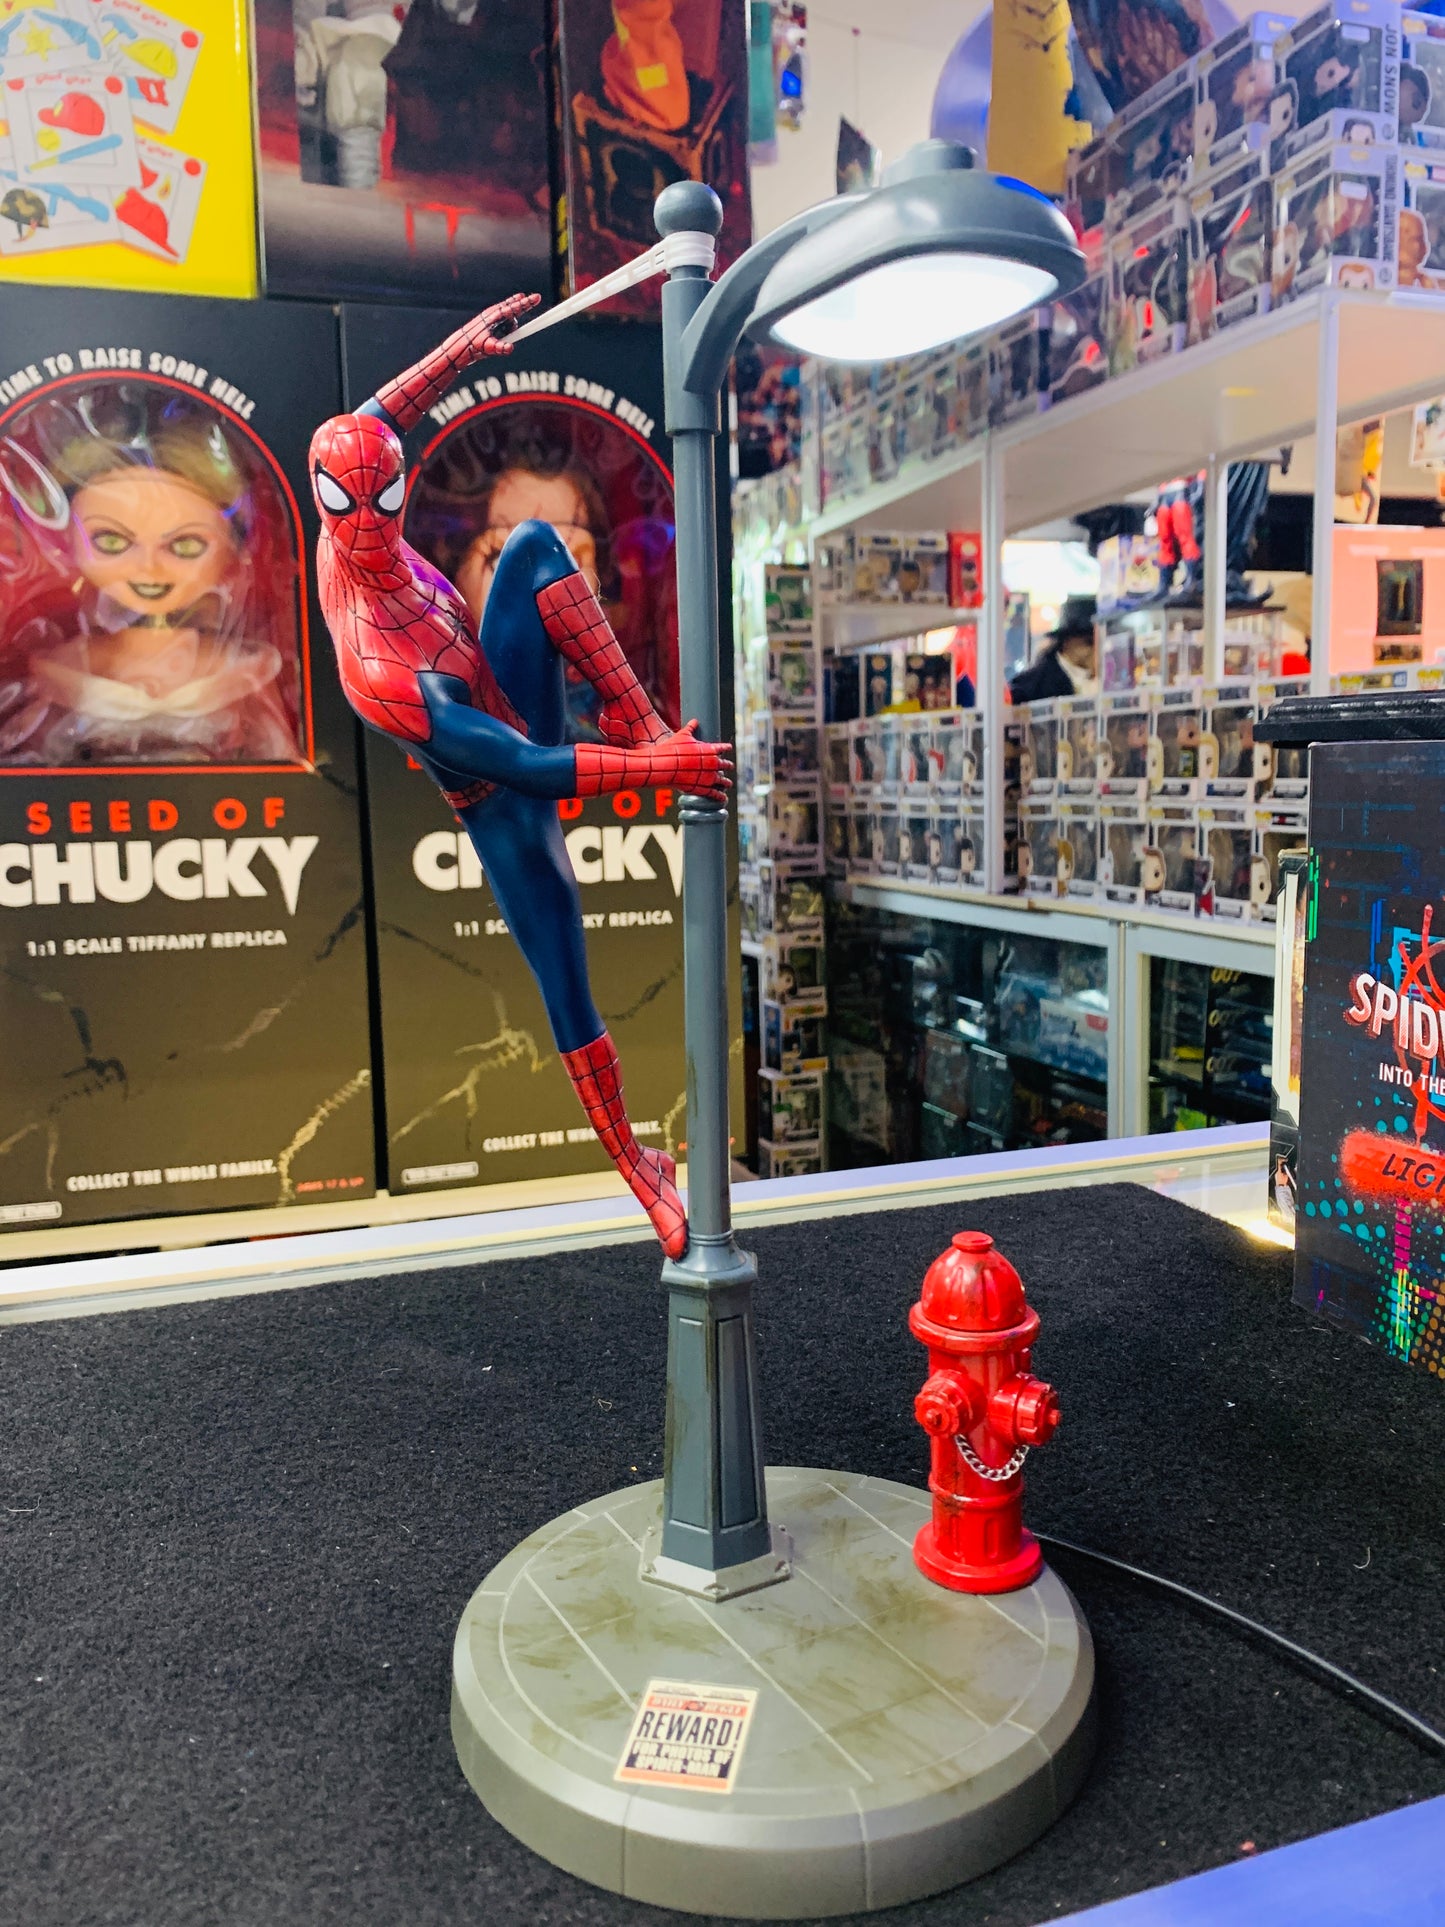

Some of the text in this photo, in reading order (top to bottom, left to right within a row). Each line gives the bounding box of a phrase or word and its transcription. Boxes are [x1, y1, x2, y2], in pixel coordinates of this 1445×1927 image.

[1384, 24, 1399, 116] JON SNOW
[404, 202, 478, 277] IT
[43, 353, 74, 378] TO
[78, 348, 142, 370] RAISE
[148, 352, 209, 388] SOME
[210, 376, 256, 420] HELL
[429, 371, 655, 439] TIME TO RAISE SOME HELL
[26, 797, 286, 835] SEED OF
[612, 788, 674, 819] OF
[0, 835, 319, 916] CHUCKY
[608, 910, 674, 928] REPLICA
[64, 937, 123, 956] SCALE
[127, 933, 206, 952] TIFFANY
[211, 929, 288, 949] REPLICA
[1379, 1062, 1413, 1087] INTO
[482, 1133, 537, 1153] COLLECT
[539, 1130, 564, 1147] THE
[67, 1171, 130, 1192] COLLECT
[132, 1168, 162, 1186] THE
[164, 1164, 218, 1184] WHOLE
[637, 1710, 743, 1748] REWARD!
